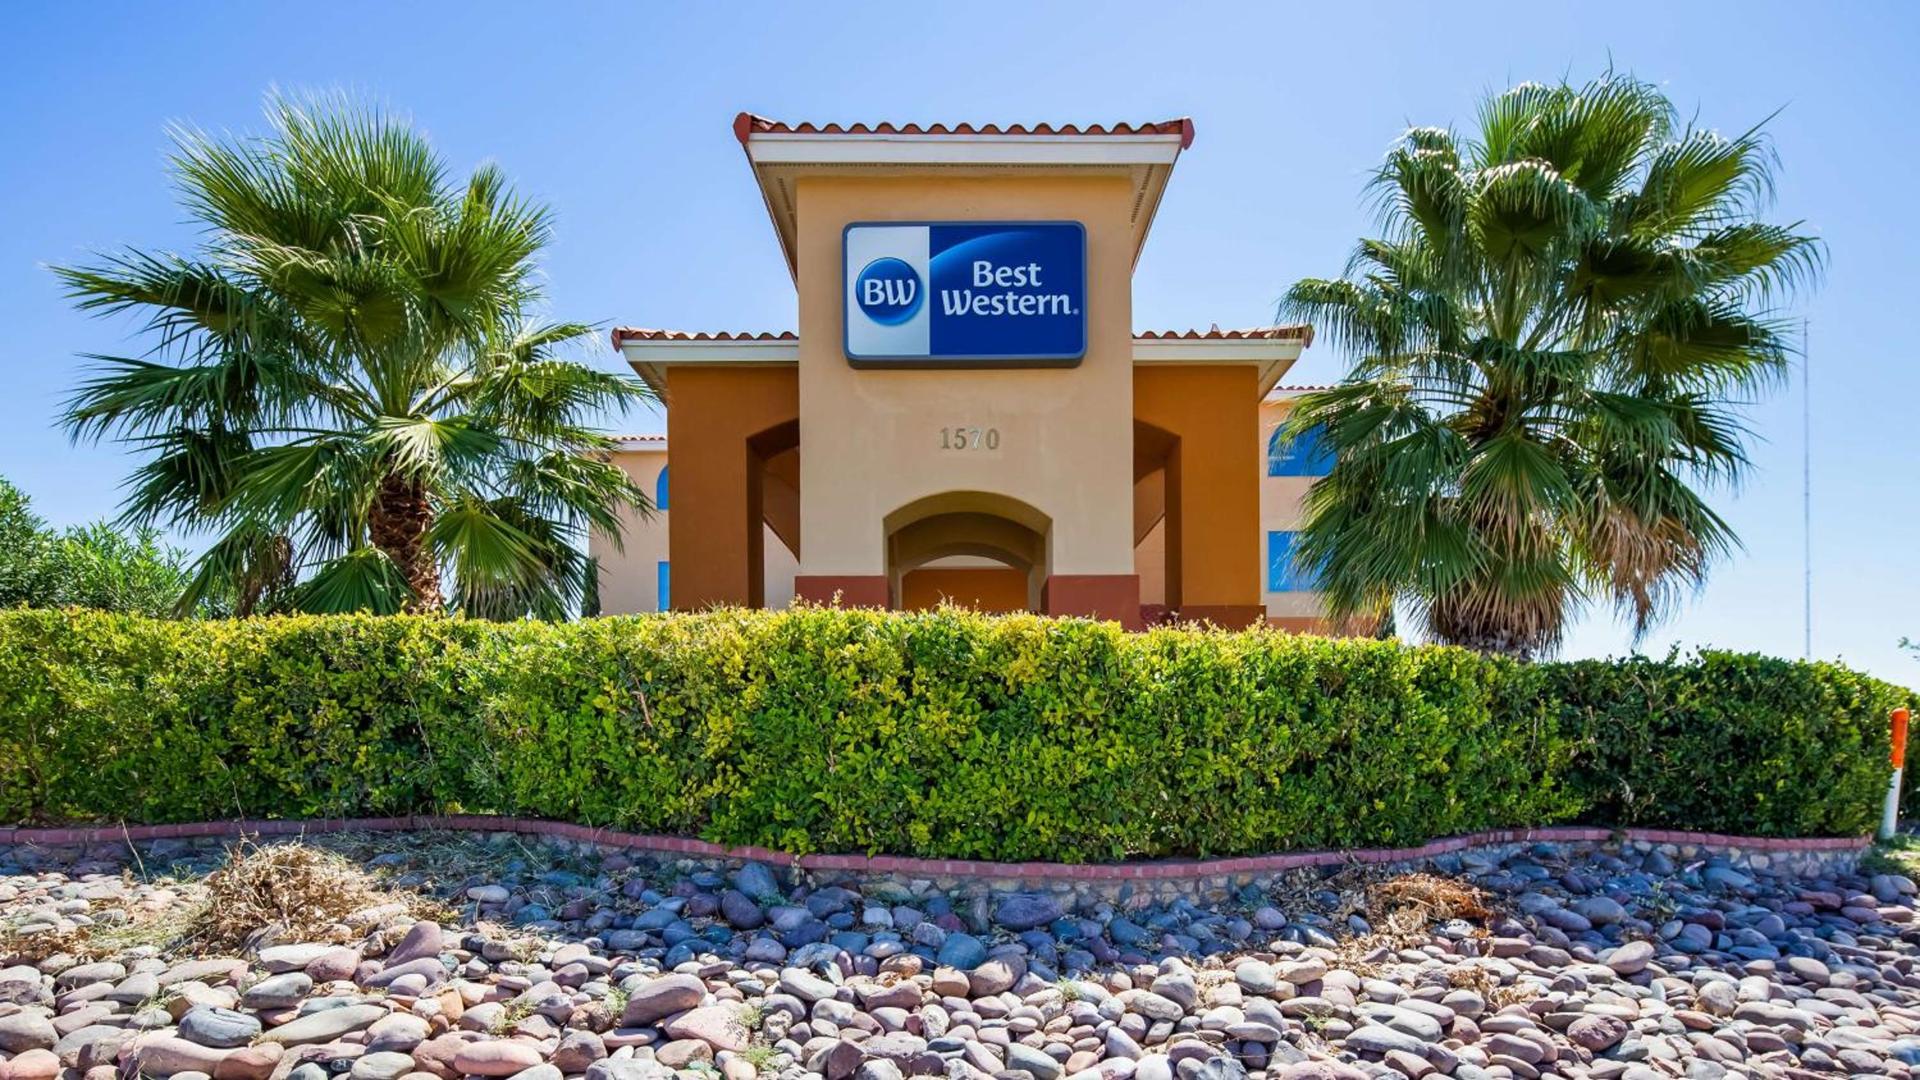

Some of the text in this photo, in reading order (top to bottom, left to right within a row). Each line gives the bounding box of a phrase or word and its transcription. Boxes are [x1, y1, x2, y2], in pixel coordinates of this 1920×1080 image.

[972, 260, 1042, 287] Best
[863, 278, 916, 306] BW
[939, 427, 1001, 450] 1570
